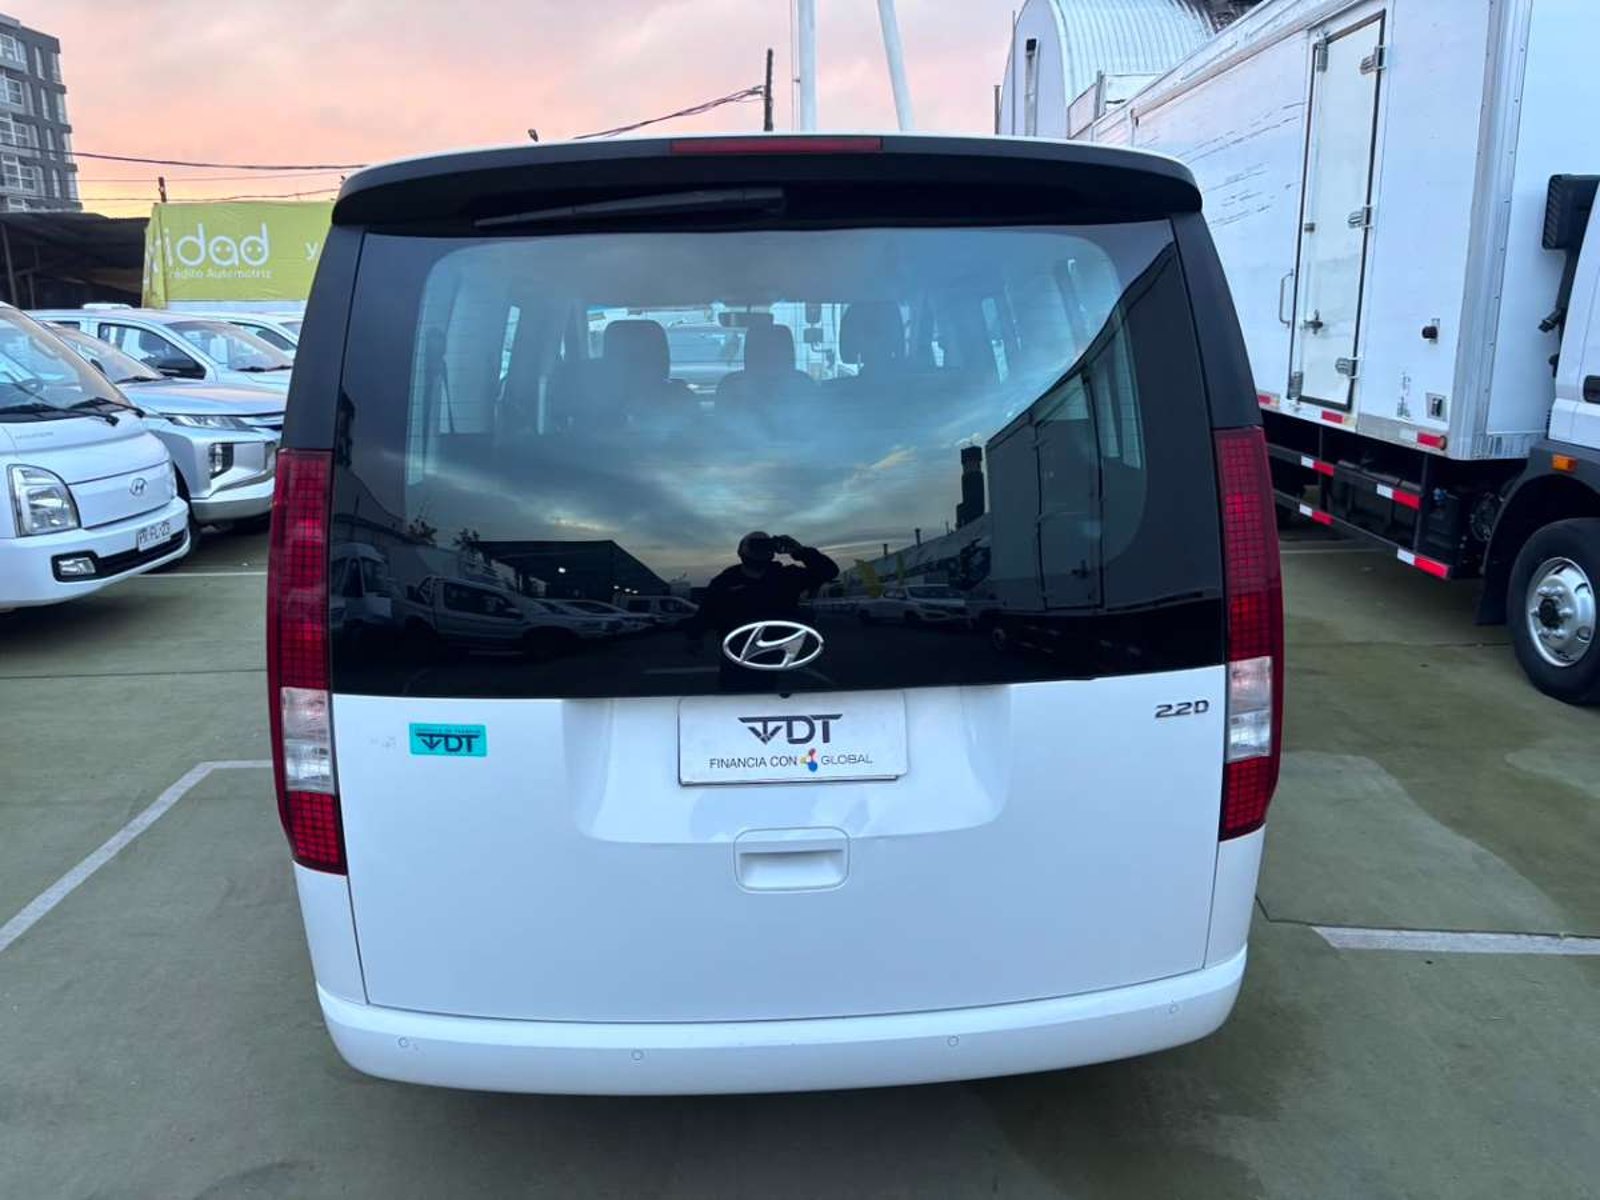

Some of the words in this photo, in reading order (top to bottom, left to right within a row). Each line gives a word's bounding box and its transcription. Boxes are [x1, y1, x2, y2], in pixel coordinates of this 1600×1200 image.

[709, 756, 767, 769] FINANCIA
[770, 754, 797, 768] CON
[821, 752, 873, 765] GLOBAL
